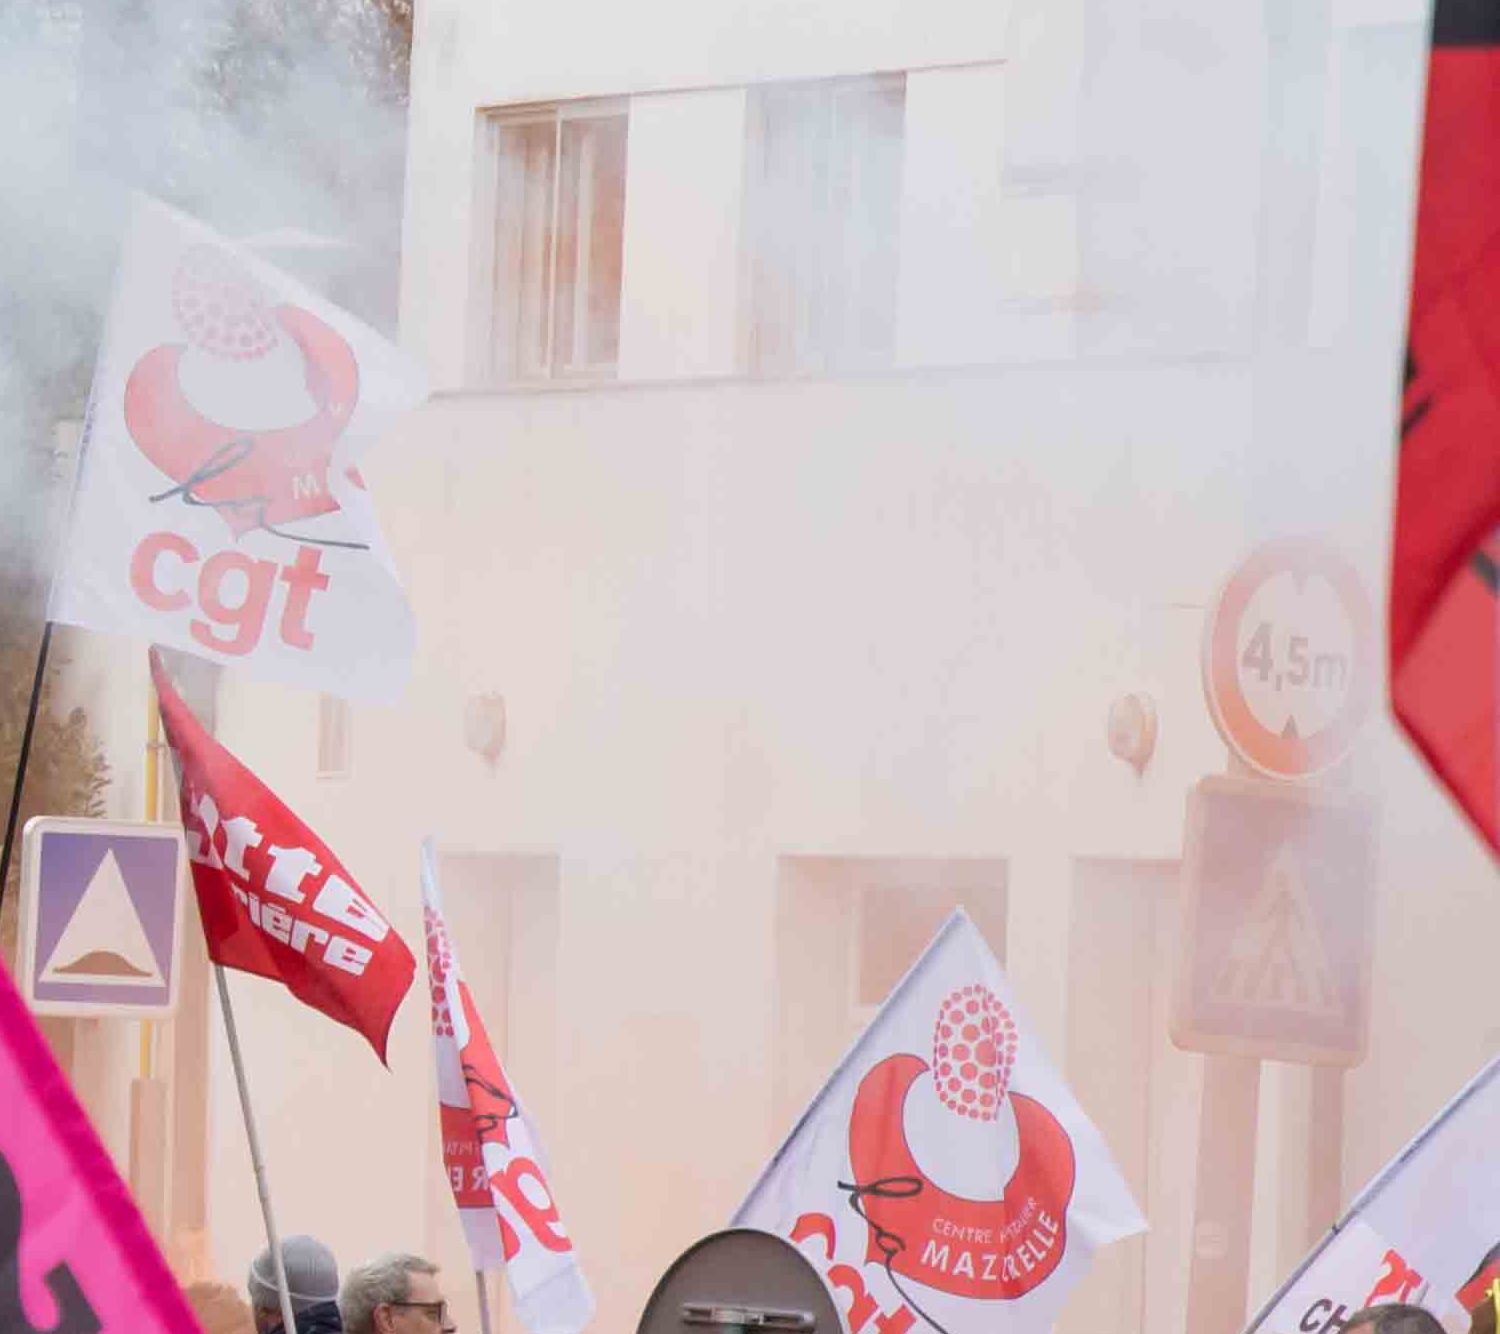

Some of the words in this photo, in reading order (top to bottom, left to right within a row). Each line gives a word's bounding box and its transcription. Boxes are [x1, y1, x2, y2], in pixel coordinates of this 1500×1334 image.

[129, 531, 332, 657] cgt
[1241, 621, 1347, 692] 4,5m
[921, 1210, 1059, 1282] MAZRELLE
[932, 1217, 993, 1244] CENTRE
